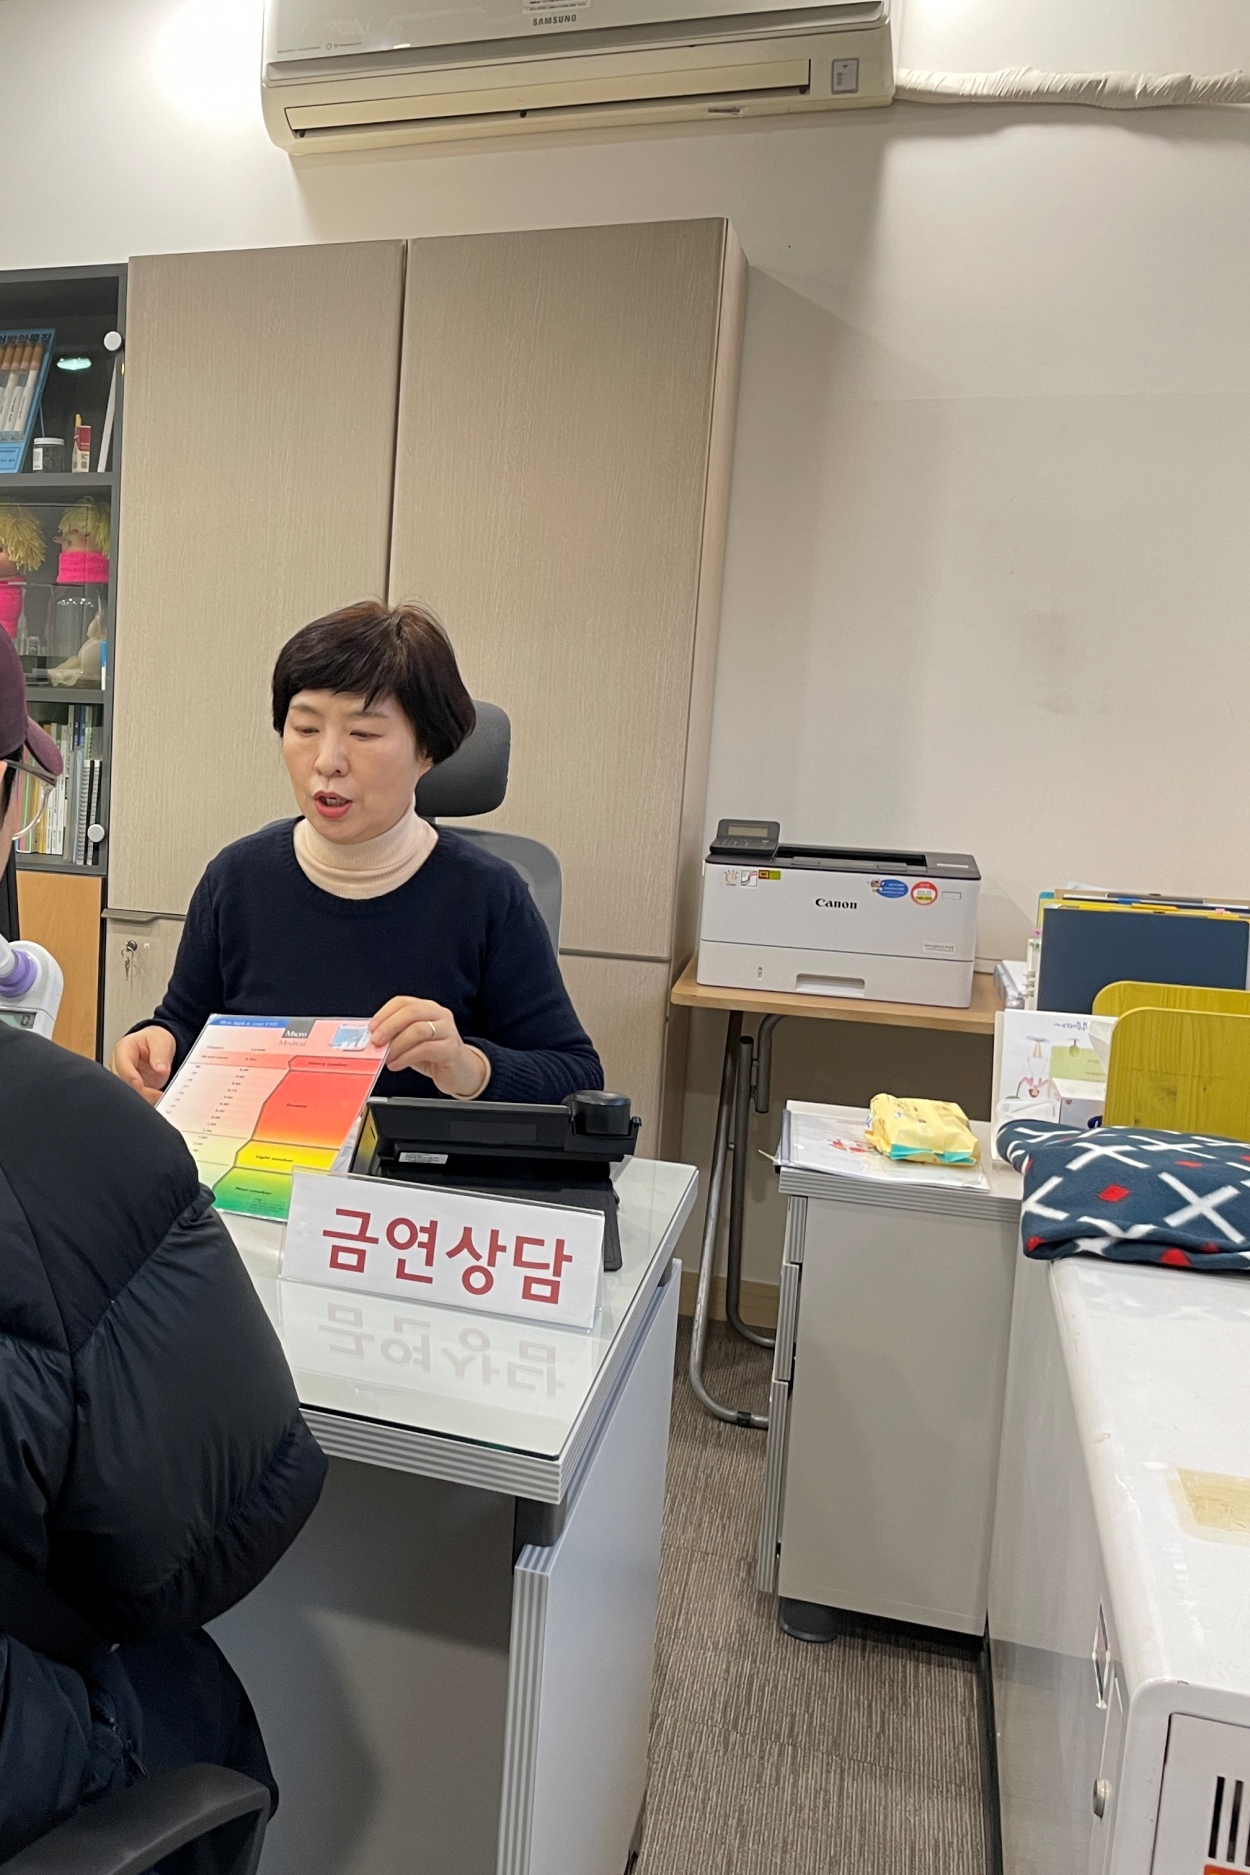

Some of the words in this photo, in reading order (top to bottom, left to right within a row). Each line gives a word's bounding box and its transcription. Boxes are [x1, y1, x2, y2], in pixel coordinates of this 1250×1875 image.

[533, 14, 577, 26] SAMSUNG
[815, 898, 857, 910] Canon
[285, 1030, 308, 1038] Micro
[322, 1207, 573, 1305] 금연상담
